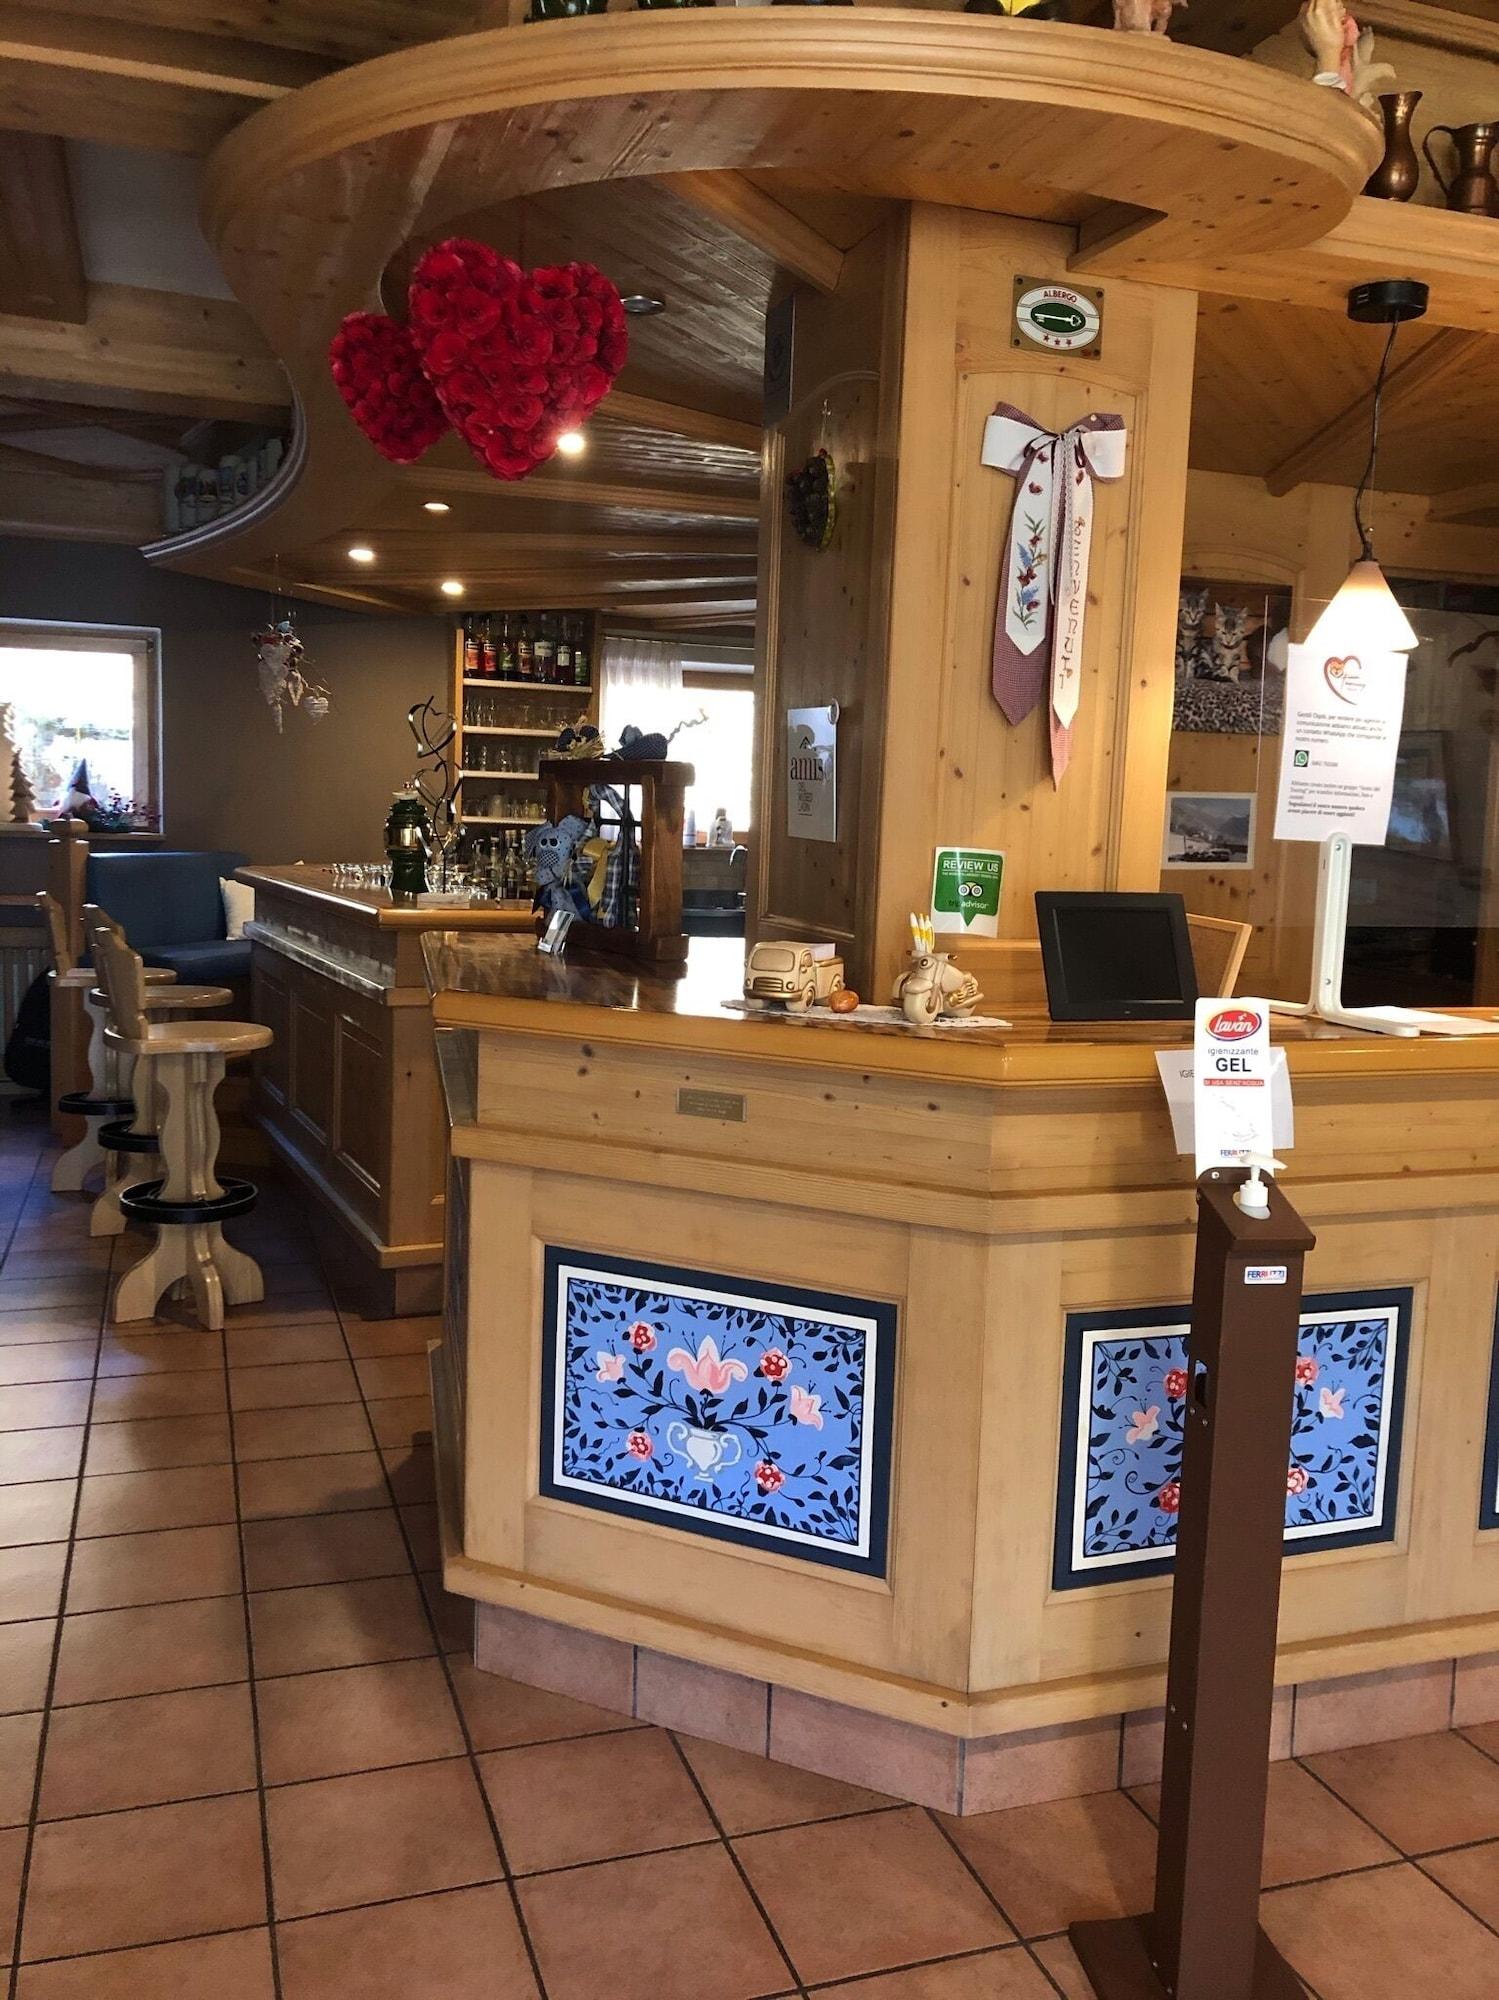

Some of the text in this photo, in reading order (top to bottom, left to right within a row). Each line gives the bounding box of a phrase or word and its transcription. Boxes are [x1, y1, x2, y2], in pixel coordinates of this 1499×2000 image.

[1043, 289, 1078, 303] ALBERGO
[943, 860, 999, 872] REVIEW US
[1215, 1057, 1252, 1072] GEL
